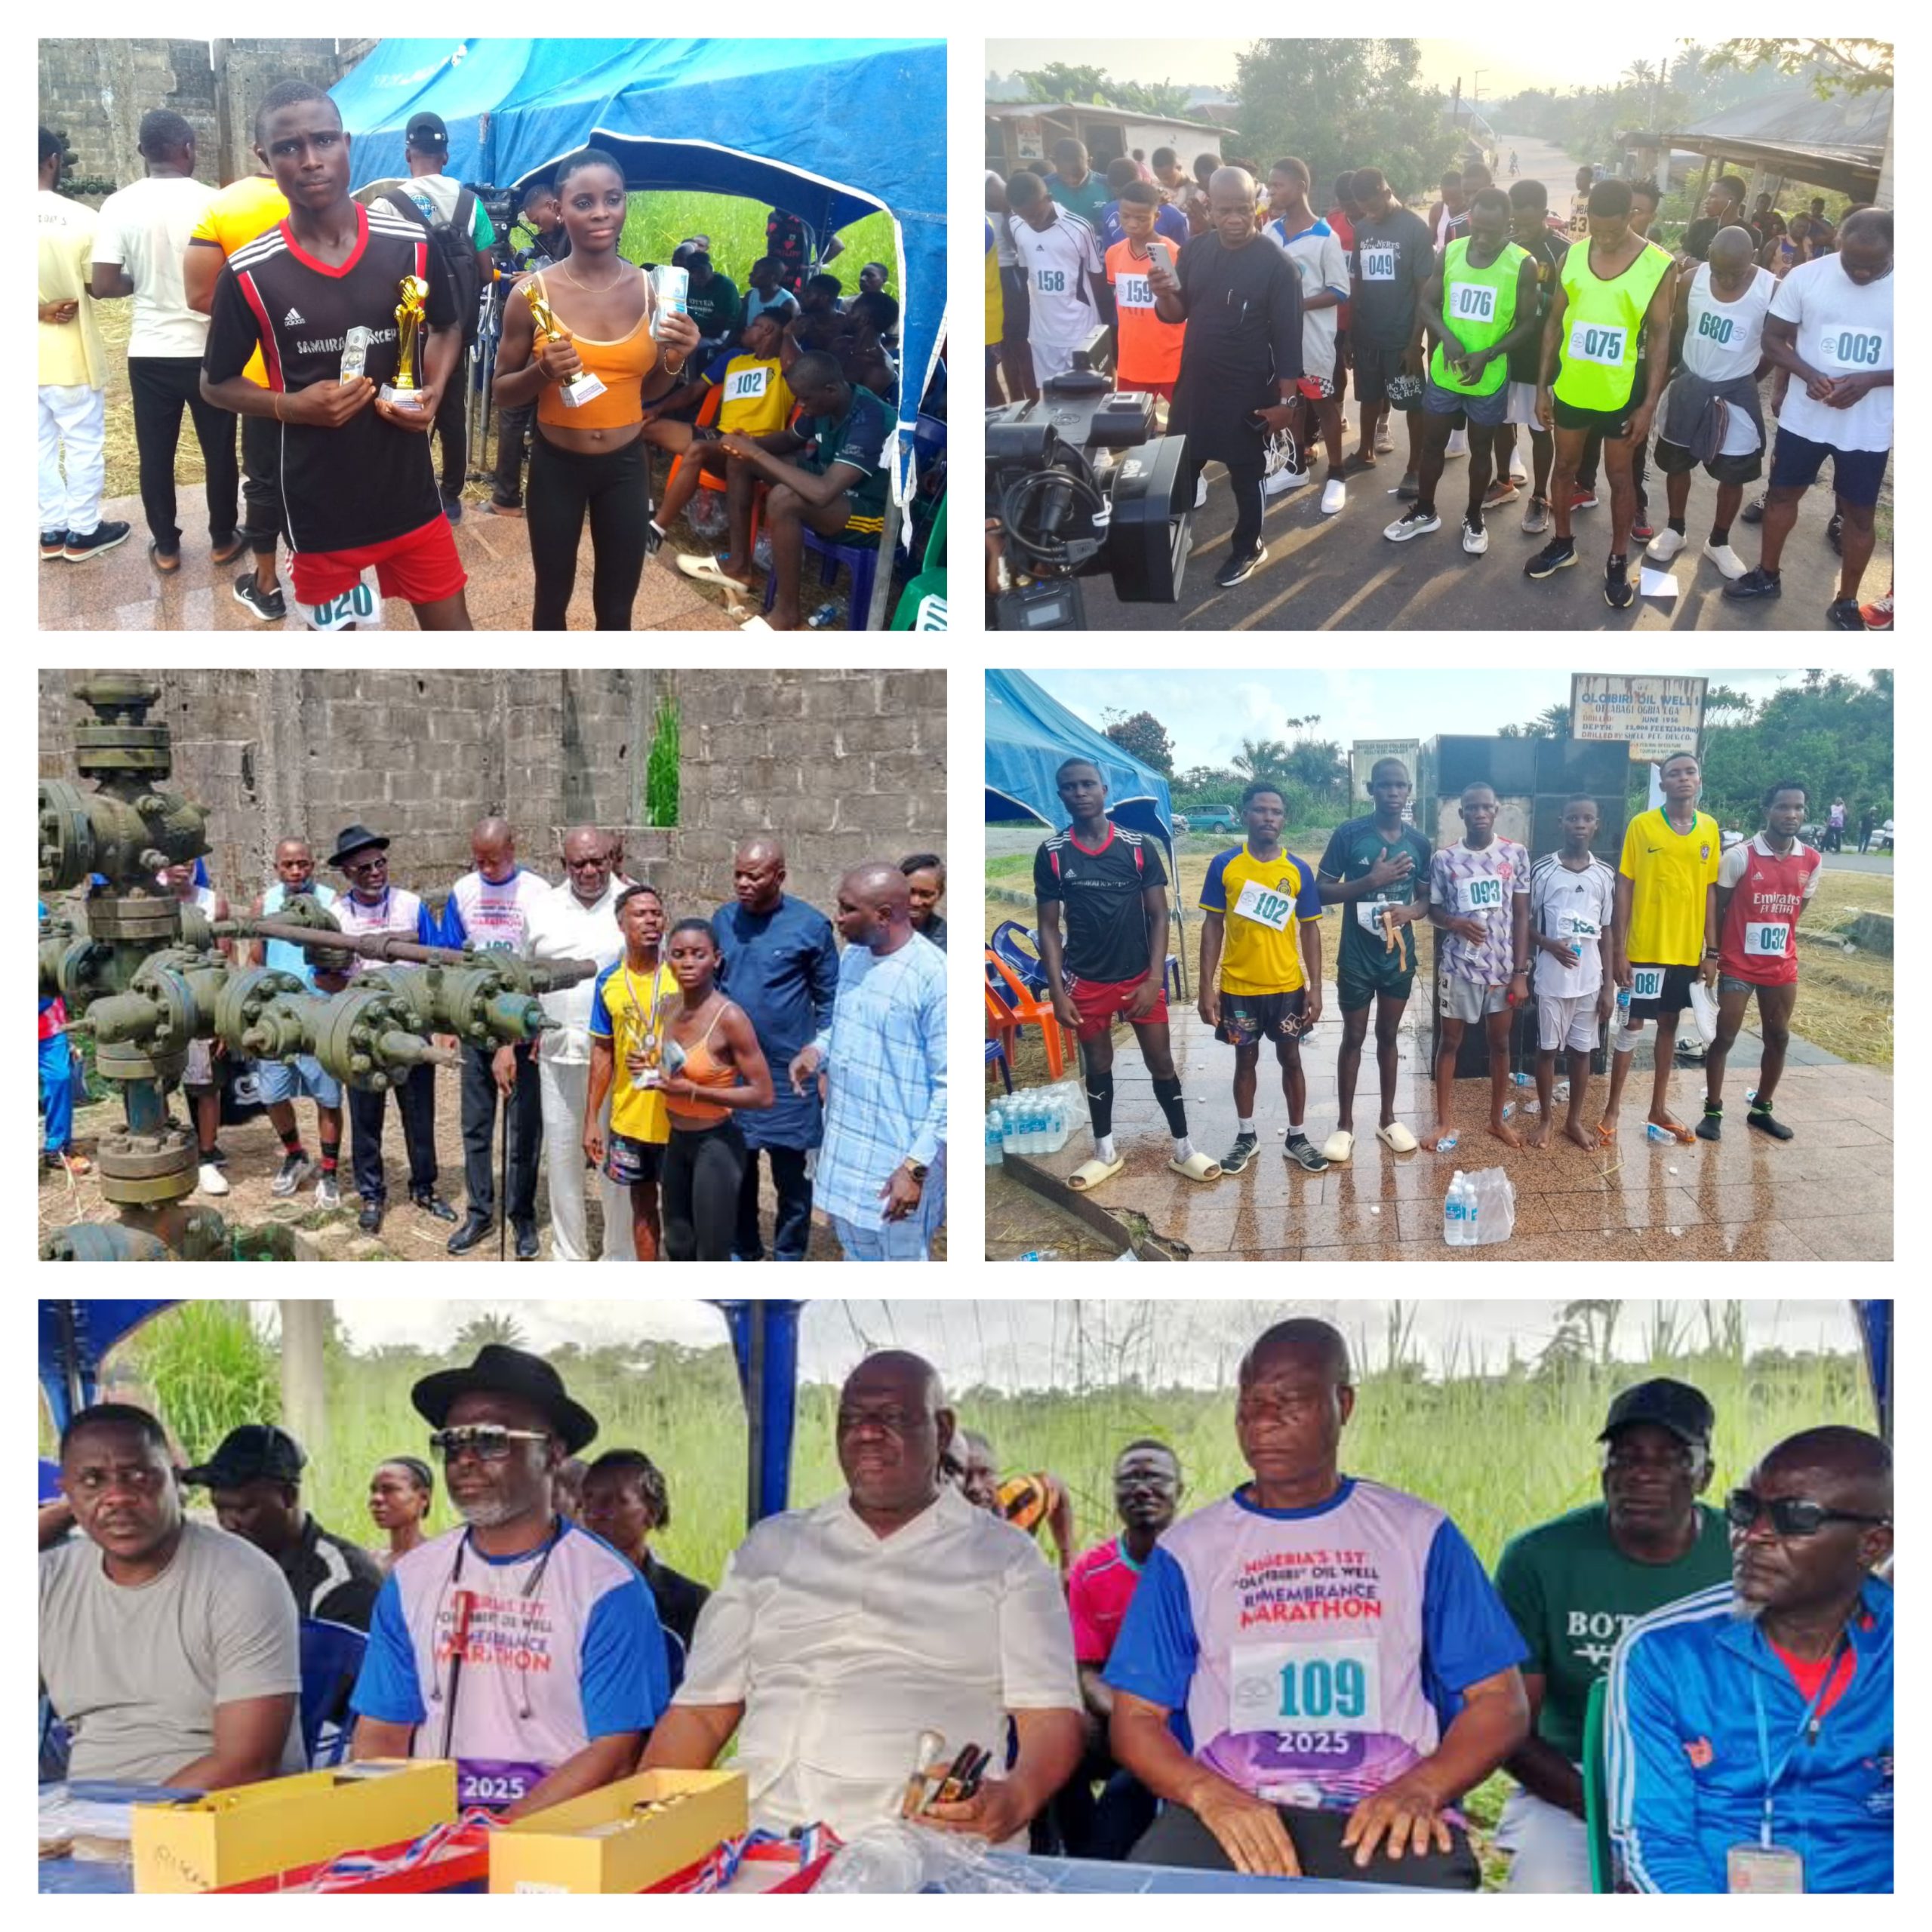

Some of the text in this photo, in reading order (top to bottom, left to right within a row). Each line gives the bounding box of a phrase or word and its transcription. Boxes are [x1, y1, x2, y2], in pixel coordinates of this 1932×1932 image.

[1570, 217, 1587, 232] 23
[1368, 255, 1393, 275] 049
[1038, 270, 1065, 291] 158
[1127, 280, 1153, 303] 159
[1460, 288, 1492, 316] 076
[1698, 312, 1734, 343] 680
[297, 337, 346, 354] SAMURA
[1585, 329, 1622, 360] 075
[1838, 332, 1882, 365] 003
[736, 372, 762, 394] 102
[314, 583, 373, 626] 020
[1582, 693, 1632, 703] OLOIBIRI
[1638, 694, 1656, 705] OIL
[1661, 694, 1691, 706] WELL
[1470, 879, 1500, 904] 093
[1753, 891, 1801, 905] Emirates
[1253, 892, 1289, 924] 102
[1761, 928, 1786, 950] 032
[1635, 973, 1660, 995] 081
[1312, 1567, 1337, 1579] OIL
[1341, 1567, 1380, 1580] WELL
[1241, 1598, 1382, 1629] MARATHON
[1278, 1658, 1365, 1718] 109
[1277, 1732, 1349, 1754] 2025
[463, 1777, 524, 1799] 2025
